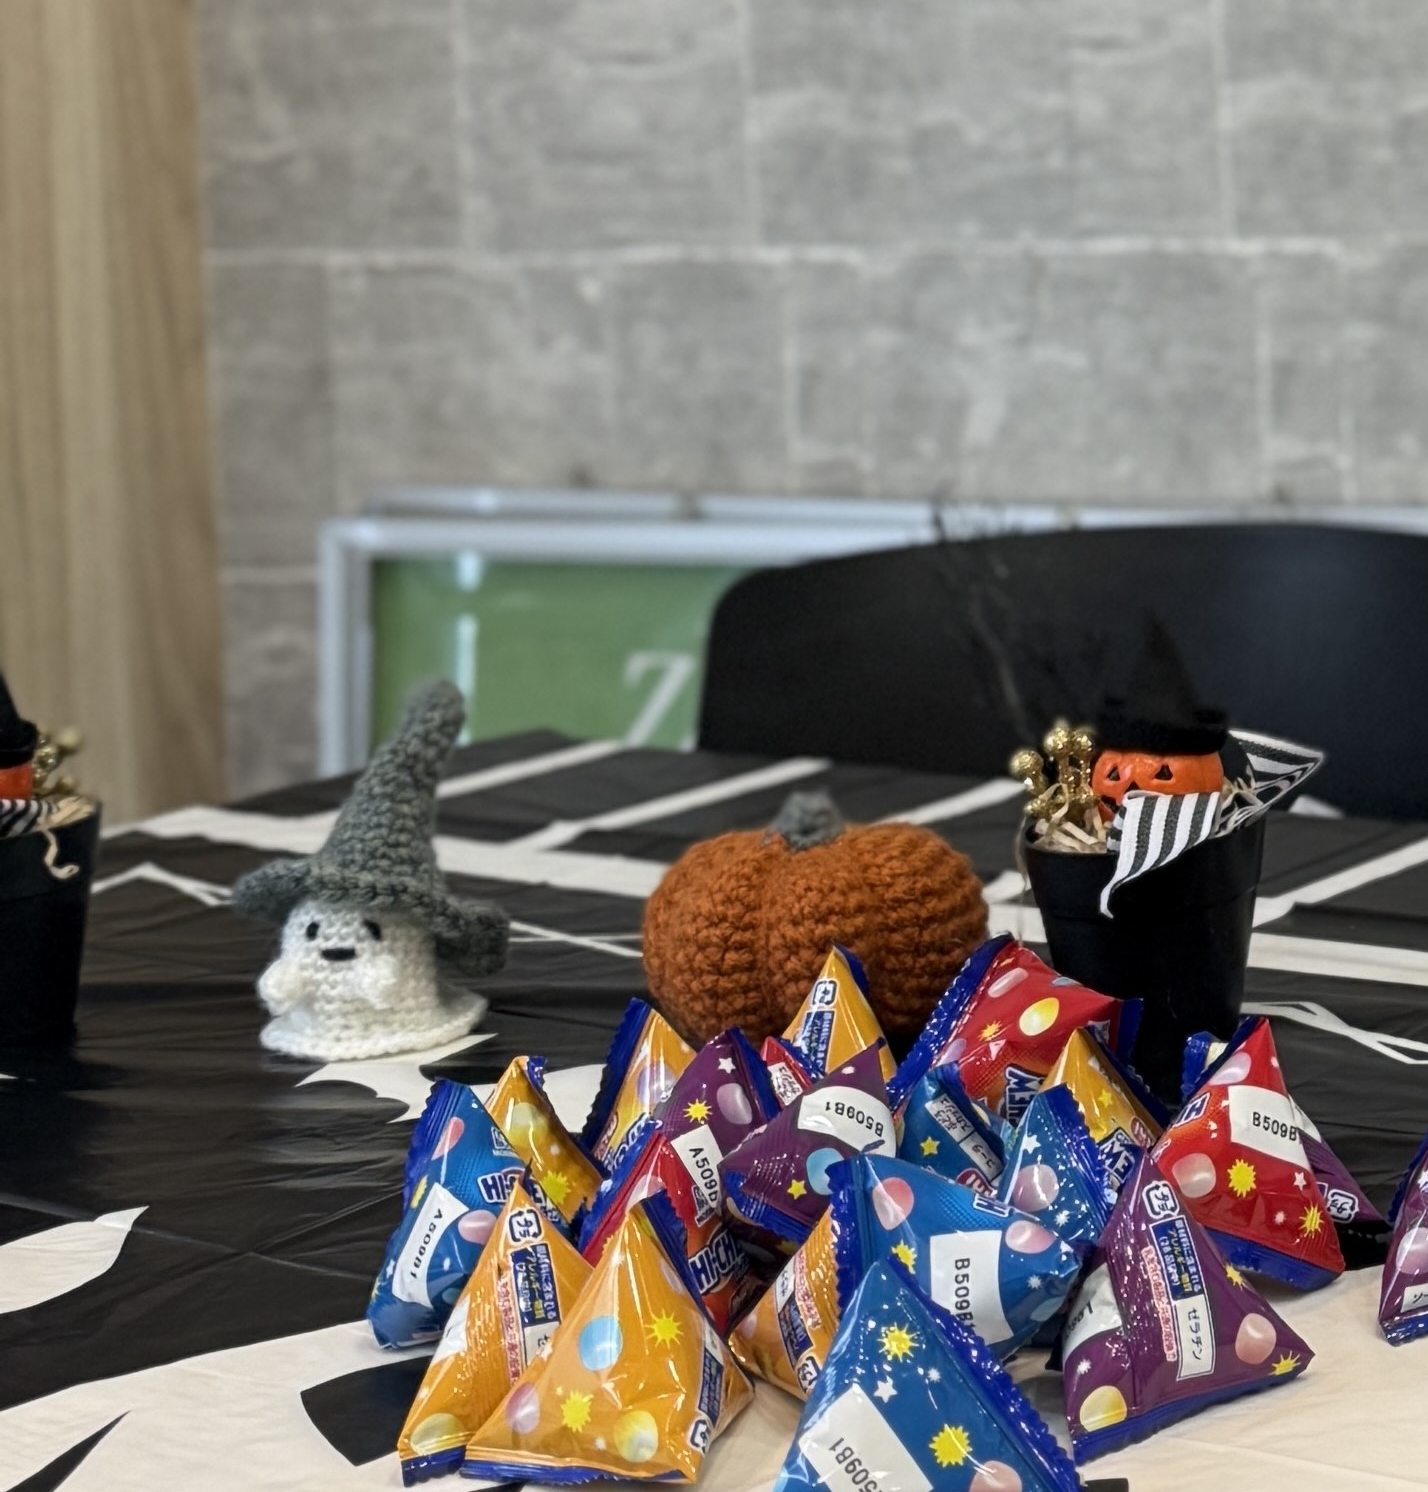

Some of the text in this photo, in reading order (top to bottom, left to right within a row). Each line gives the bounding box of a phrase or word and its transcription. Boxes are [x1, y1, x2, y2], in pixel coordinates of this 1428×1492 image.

[825, 1101, 885, 1138] B509B1
[1252, 1111, 1301, 1143] B509B
[1186, 1308, 1203, 1361] ゼラチン
[828, 1436, 883, 1492] 509B1
